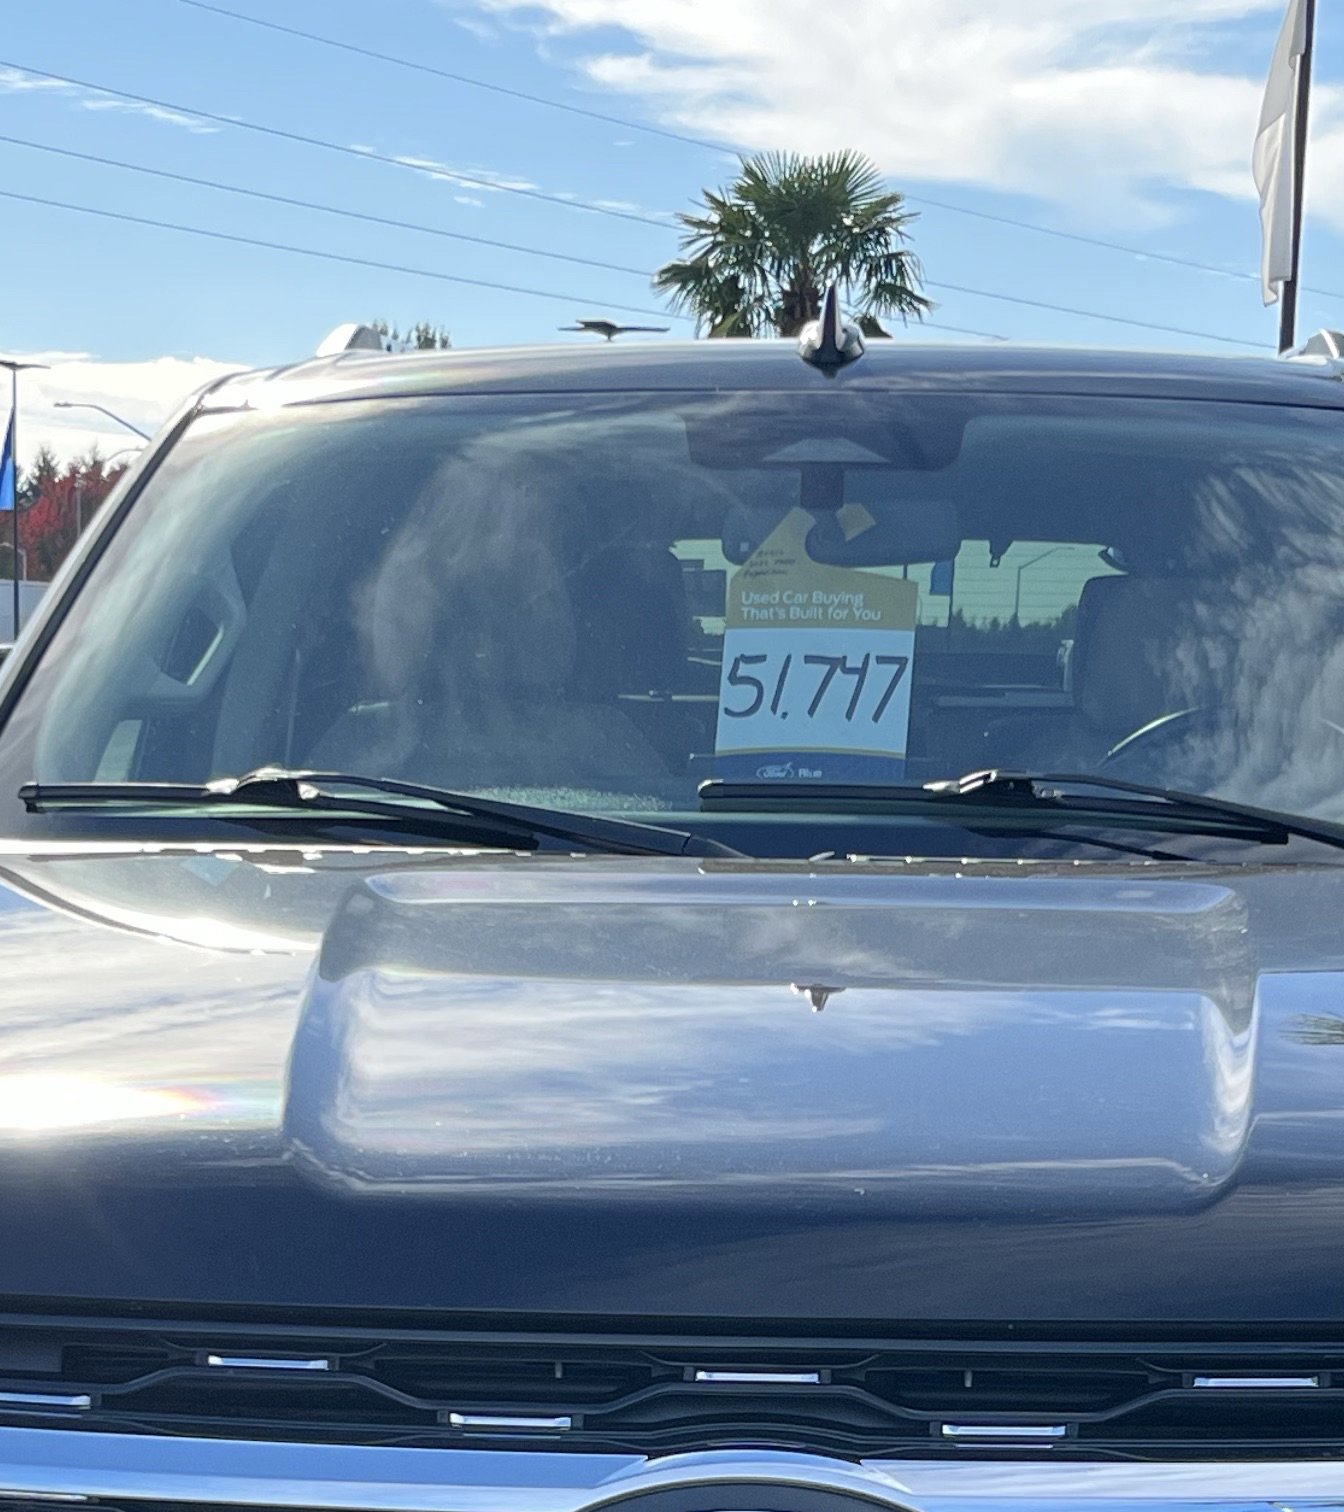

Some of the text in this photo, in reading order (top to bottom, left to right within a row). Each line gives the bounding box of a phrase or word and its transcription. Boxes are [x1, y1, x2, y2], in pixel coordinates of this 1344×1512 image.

[741, 590, 864, 608] Used Car Buying
[741, 606, 882, 621] That's Built for You
